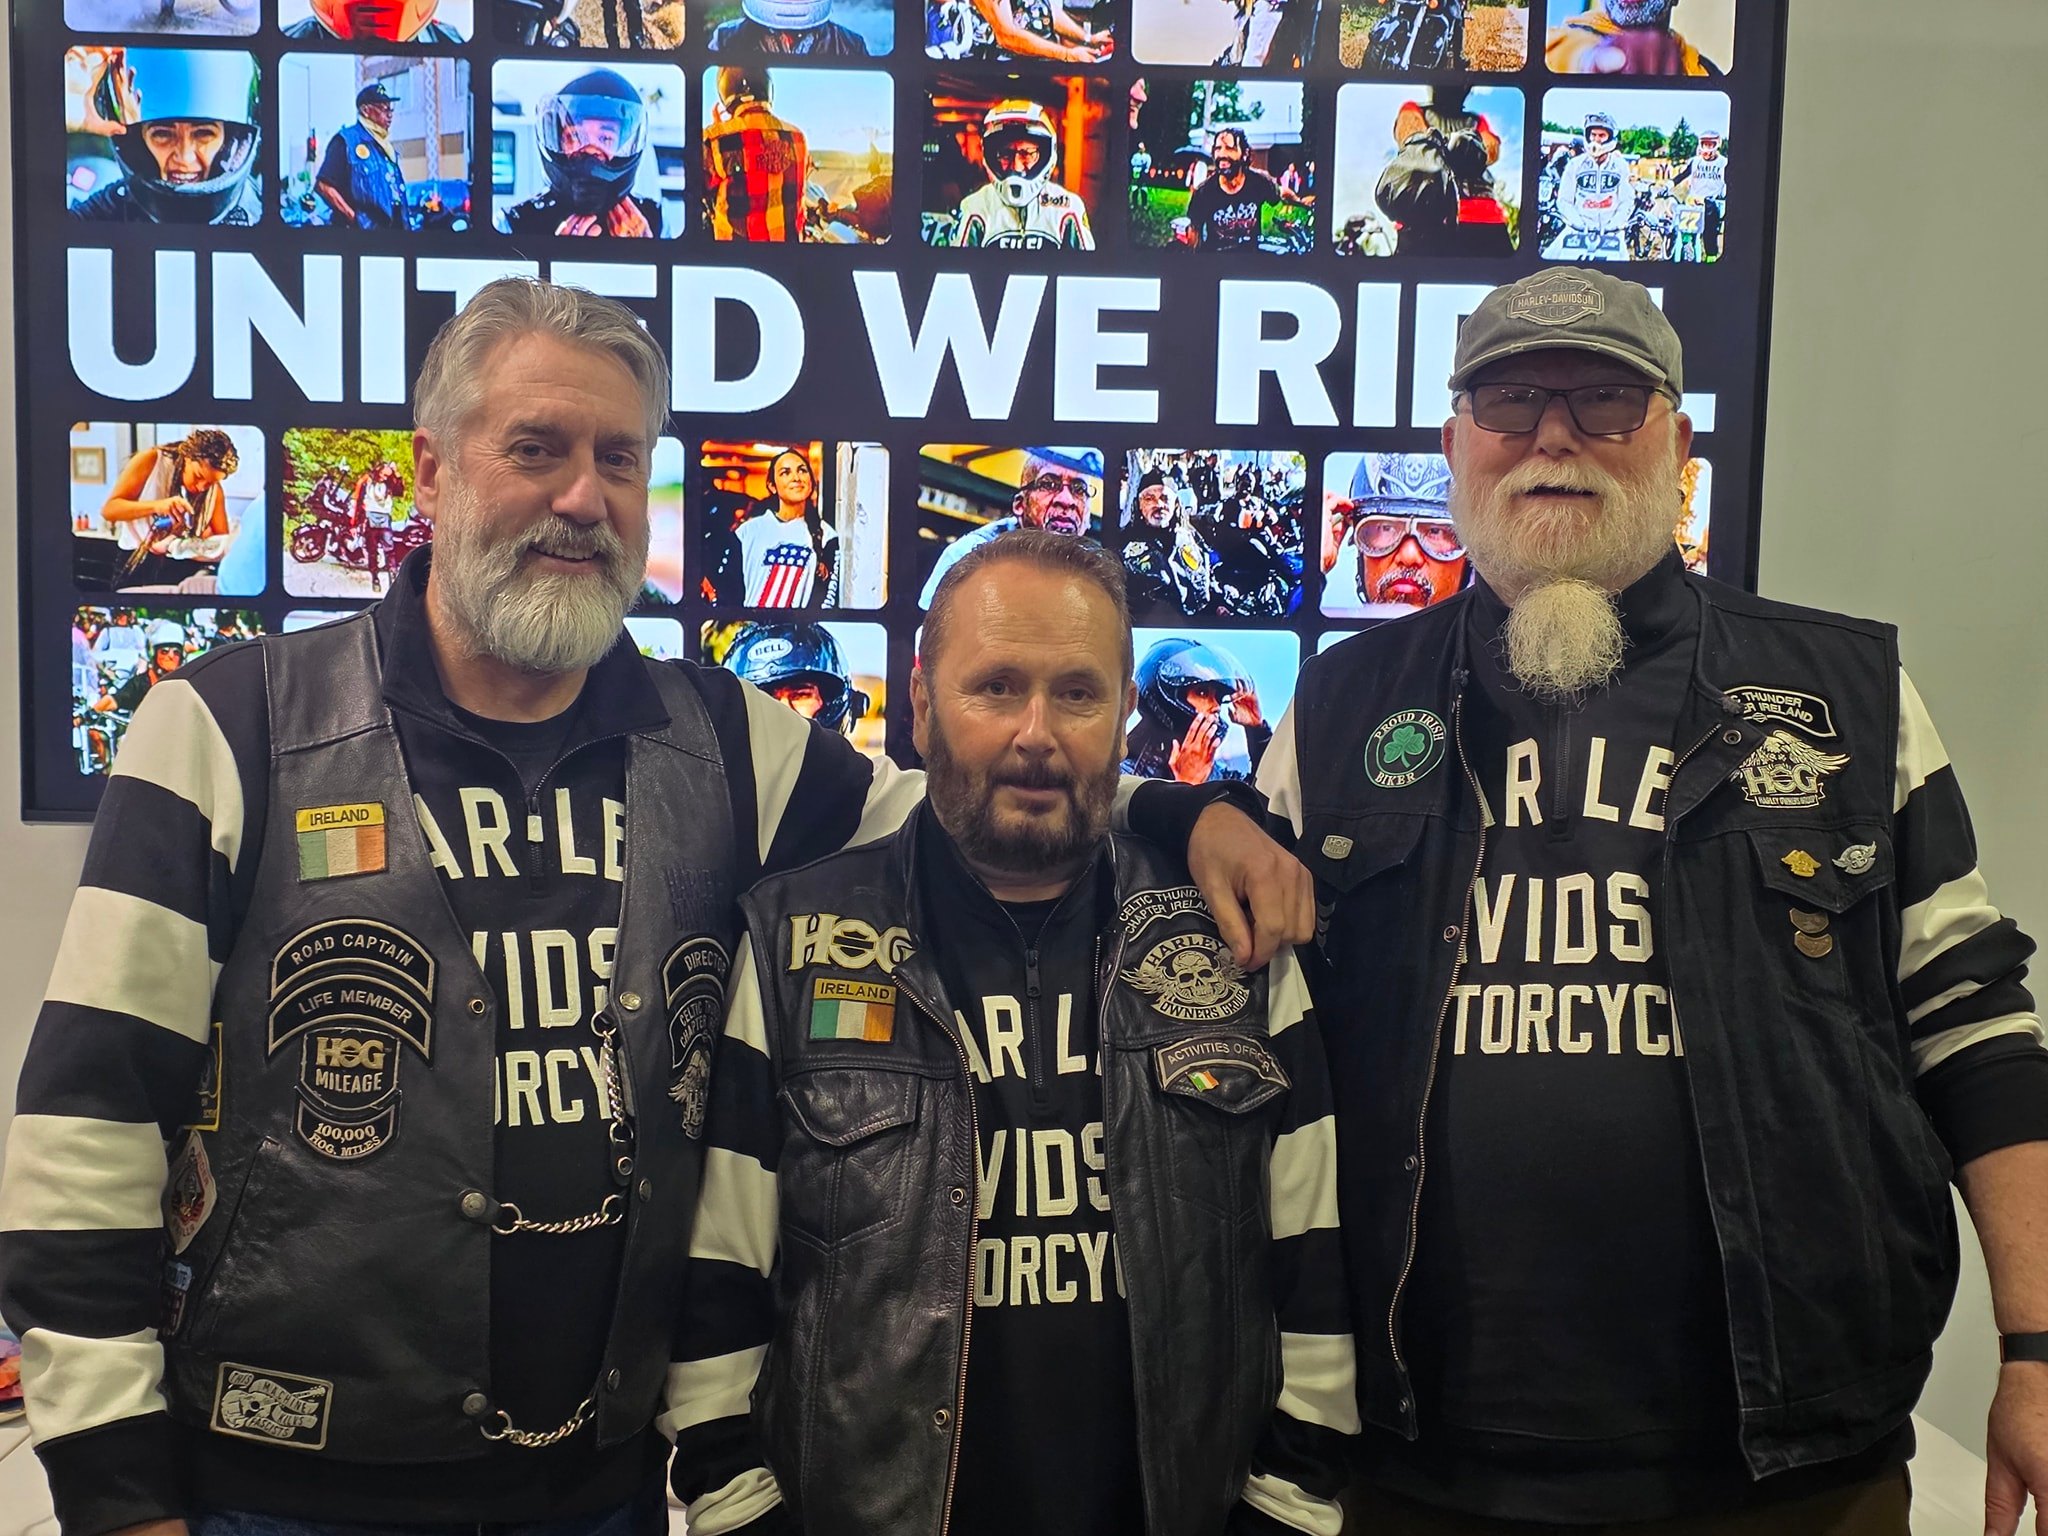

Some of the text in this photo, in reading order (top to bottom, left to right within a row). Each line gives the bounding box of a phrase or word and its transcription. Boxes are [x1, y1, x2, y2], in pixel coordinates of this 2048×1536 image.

[1583, 176, 1615, 188] FUEL
[1518, 293, 1594, 307] HARLEY-DAVIDSON
[66, 246, 805, 414] UNID
[852, 270, 1161, 423] WE
[755, 643, 784, 656] BELL
[1741, 691, 1802, 707] THUNDER
[1758, 702, 1814, 723] IRELAND
[1374, 712, 1444, 741] PROUD IRISH
[1375, 771, 1416, 786] BIKER
[1741, 763, 1818, 796] HOG
[310, 808, 369, 826] IRELAND
[1119, 894, 1153, 922] CELTIC
[1125, 904, 1167, 934] CHAPTER
[1462, 871, 1653, 965] VIDS
[291, 933, 415, 967] ROAD CAPTAIN
[788, 912, 917, 974] HOG
[1146, 936, 1224, 969] HARLEY
[820, 981, 890, 999] IRELAND
[298, 989, 413, 1024] LIFE MEMBER
[1159, 1001, 1220, 1020] OWNERS
[1450, 983, 1684, 1056] TORCYC
[315, 1036, 386, 1070] HOG
[1167, 1042, 1230, 1065] ACTIVITIES
[315, 1068, 384, 1094] MILEAGE
[495, 1046, 612, 1128] RCY
[314, 1122, 376, 1143] 100,000
[340, 1135, 381, 1157] MILES
[973, 1231, 1126, 1308] ORCY
[231, 1372, 253, 1384] THIS
[262, 1382, 307, 1414] MACHINE
[249, 1417, 289, 1438] FASCISTS
